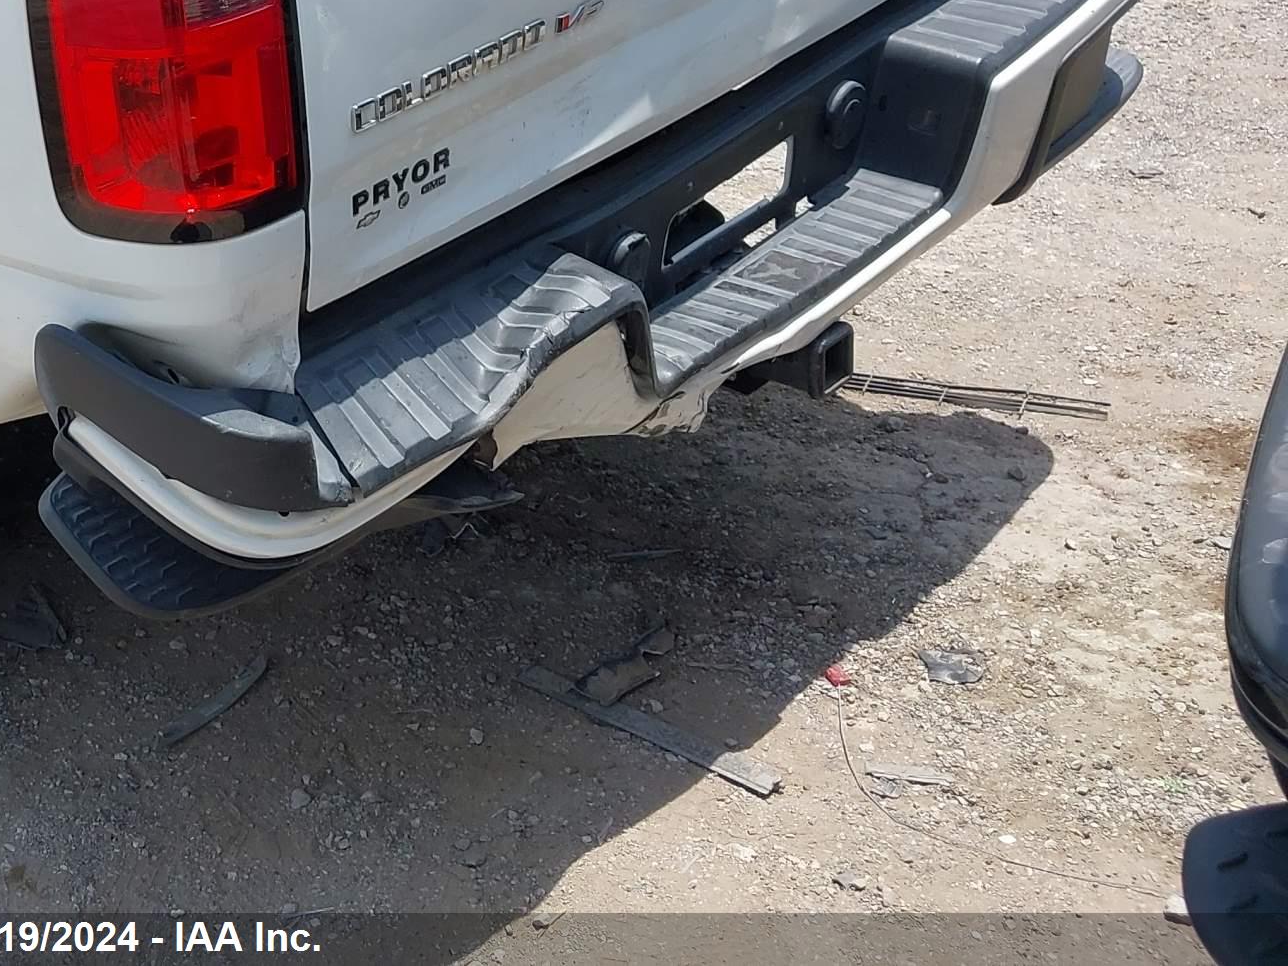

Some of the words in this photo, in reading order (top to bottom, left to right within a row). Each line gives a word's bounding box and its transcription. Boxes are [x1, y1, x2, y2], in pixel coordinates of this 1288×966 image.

[351, 18, 546, 133] COLORADO
[352, 147, 450, 217] PRYOR
[420, 174, 447, 194] GMC
